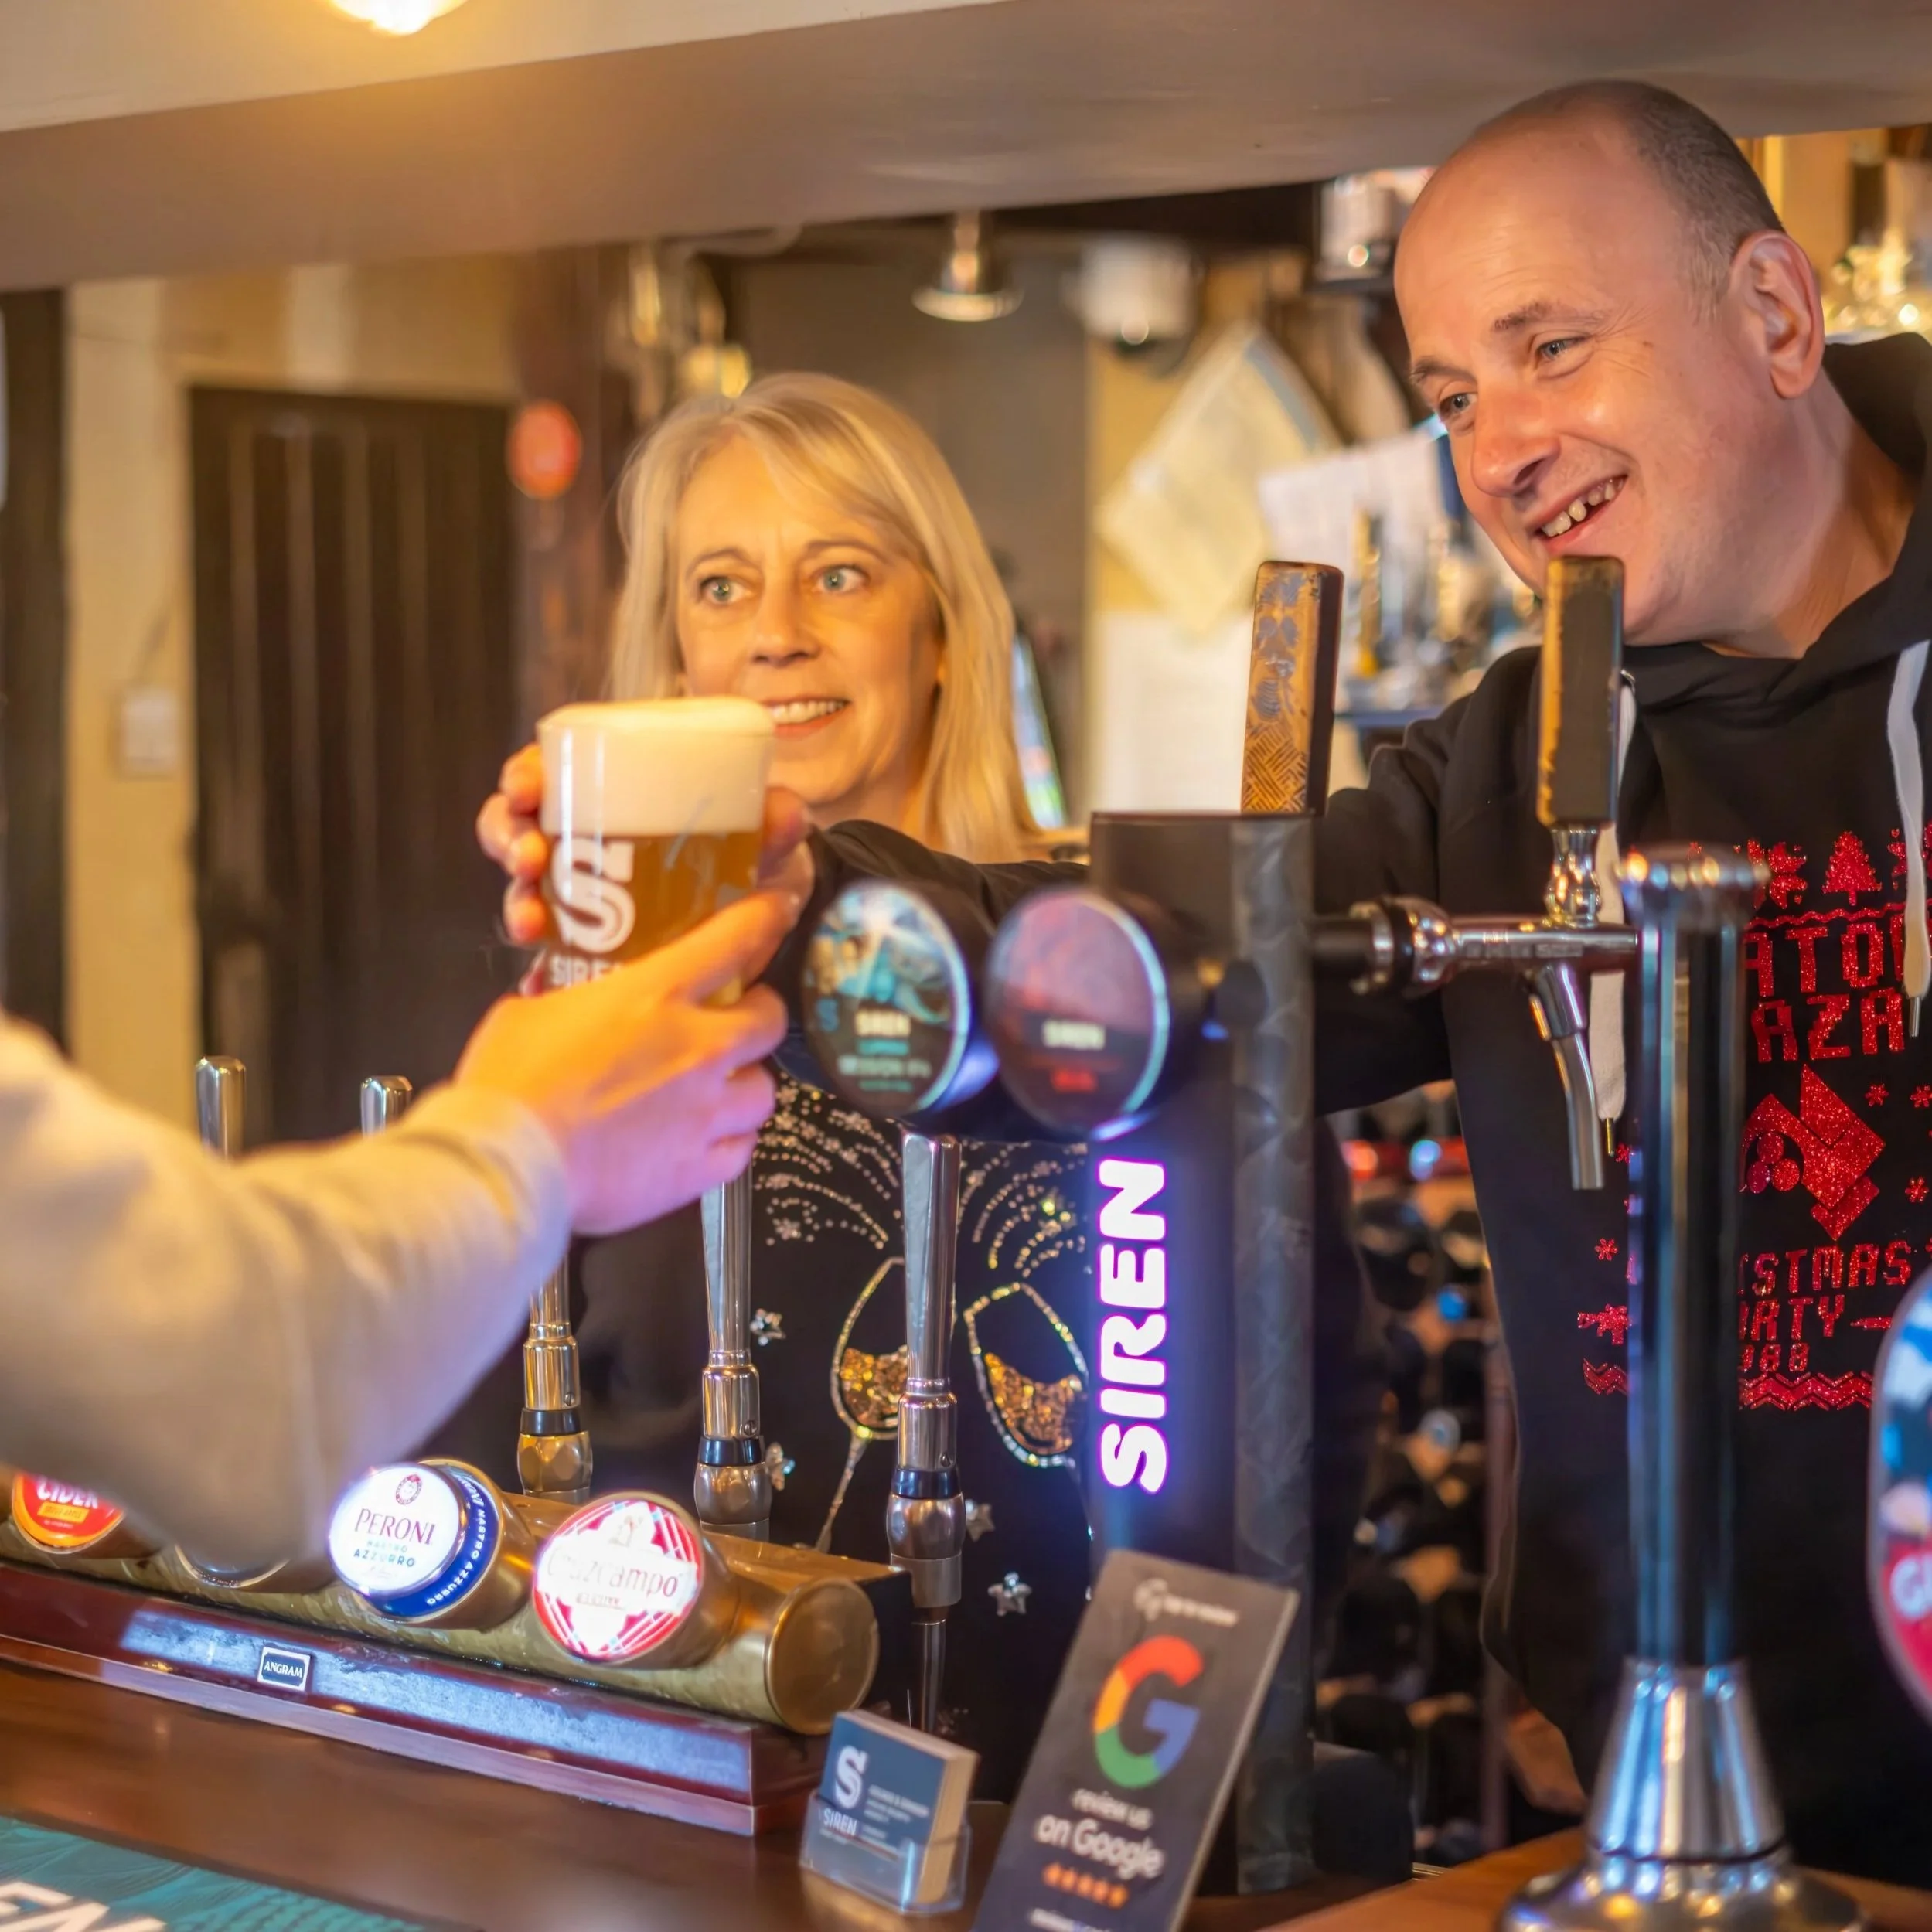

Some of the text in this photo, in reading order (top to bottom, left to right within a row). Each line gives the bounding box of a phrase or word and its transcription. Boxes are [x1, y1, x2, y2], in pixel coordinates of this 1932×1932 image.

[551, 838, 635, 954] S
[550, 956, 621, 987] SIRE
[1744, 914, 1932, 997] ATO
[1739, 1240, 1912, 1296] STMAS
[1098, 1158, 1168, 1494] SIREN
[1739, 1294, 1845, 1341] RTY
[354, 1508, 436, 1545] PERONI
[471, 1508, 487, 1560] NASTRO
[353, 1549, 416, 1568] AZZURRO
[426, 1561, 474, 1606] AZZURRO
[263, 1661, 303, 1678] ANGRAM
[1094, 1634, 1204, 1788] G
[823, 1808, 857, 1836] SIREN
[1037, 1814, 1165, 1880] on Google
